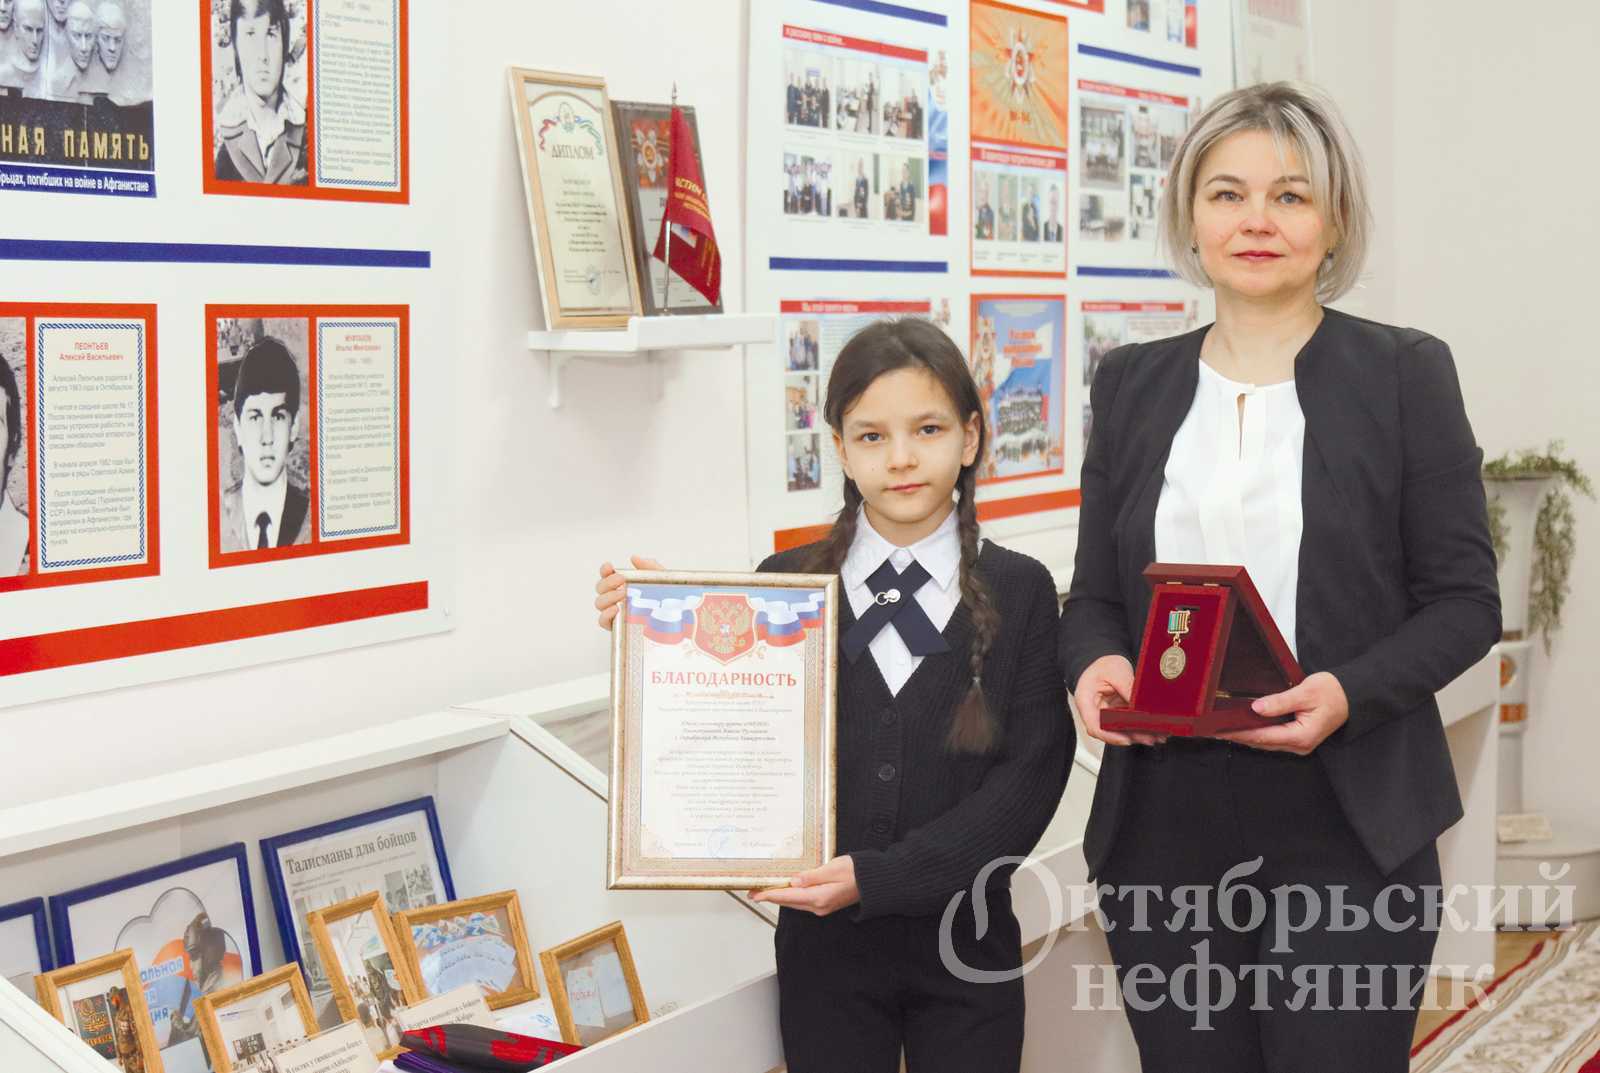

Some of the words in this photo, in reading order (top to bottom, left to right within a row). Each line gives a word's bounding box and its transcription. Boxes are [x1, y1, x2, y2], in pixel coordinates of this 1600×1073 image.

[63, 129, 149, 160] ПАМЯТЬ
[551, 143, 595, 160] ДИПЛОМ
[0, 170, 26, 187] рьцах,
[27, 172, 63, 187] погибших
[64, 177, 74, 188] на
[74, 175, 96, 189] войне
[103, 176, 149, 193] Афганистане
[74, 342, 109, 350] ЛЕОНТЬЕВ
[59, 352, 86, 361] Алексей
[86, 353, 124, 361] Васильевич
[651, 671, 797, 688] БЛАГОДАРНОСТЬ
[286, 847, 354, 875] Талисманы
[355, 840, 376, 857] для
[377, 831, 417, 851] бойцов
